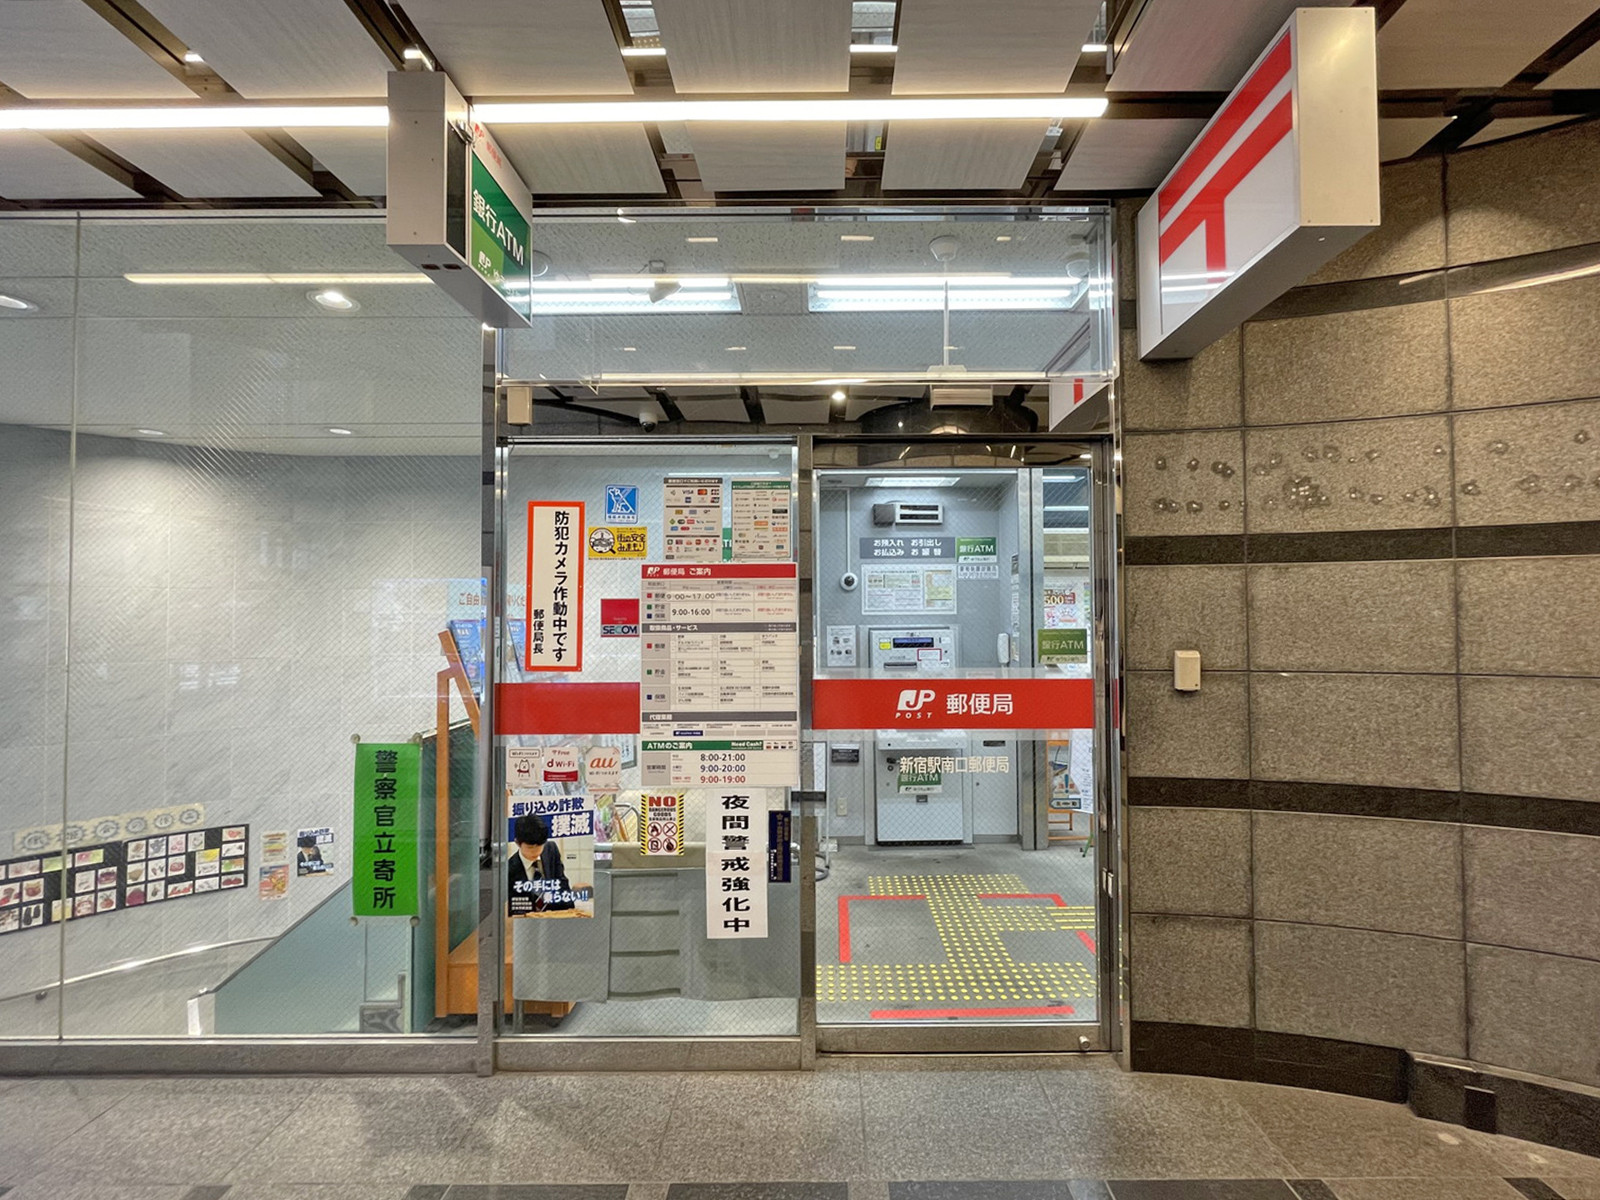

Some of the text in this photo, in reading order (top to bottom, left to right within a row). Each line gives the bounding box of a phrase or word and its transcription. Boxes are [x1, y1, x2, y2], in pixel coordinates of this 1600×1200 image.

[472, 188, 525, 268] 銀行ATM
[910, 539, 942, 547] お引出し
[873, 549, 904, 557] お払込み
[959, 545, 994, 553] 銀行ATM
[662, 568, 685, 576] 郵便局
[689, 568, 712, 576] ご案内
[552, 510, 570, 662] 防犯カメラ作動中です
[532, 608, 545, 654] 郵便局長
[602, 625, 638, 635] SECOM
[1042, 640, 1084, 650] 銀行ATM
[945, 692, 1014, 716] 郵便局
[894, 711, 933, 719] POST
[589, 757, 618, 769] au
[700, 753, 746, 762] 8:00-21:00
[556, 760, 575, 768] Wi-Fi
[700, 764, 746, 773] 9:00-20:00
[899, 756, 1010, 775] 新宿駅南口郵便局
[700, 775, 746, 784] 9:00-19:00
[512, 796, 585, 817] 振り込め詐欺
[648, 796, 677, 807] NO
[372, 749, 399, 910] 警察官立寄所
[551, 813, 591, 837] 撲滅
[721, 794, 751, 933] 夜間警戒強化中
[513, 878, 561, 893] その手には
